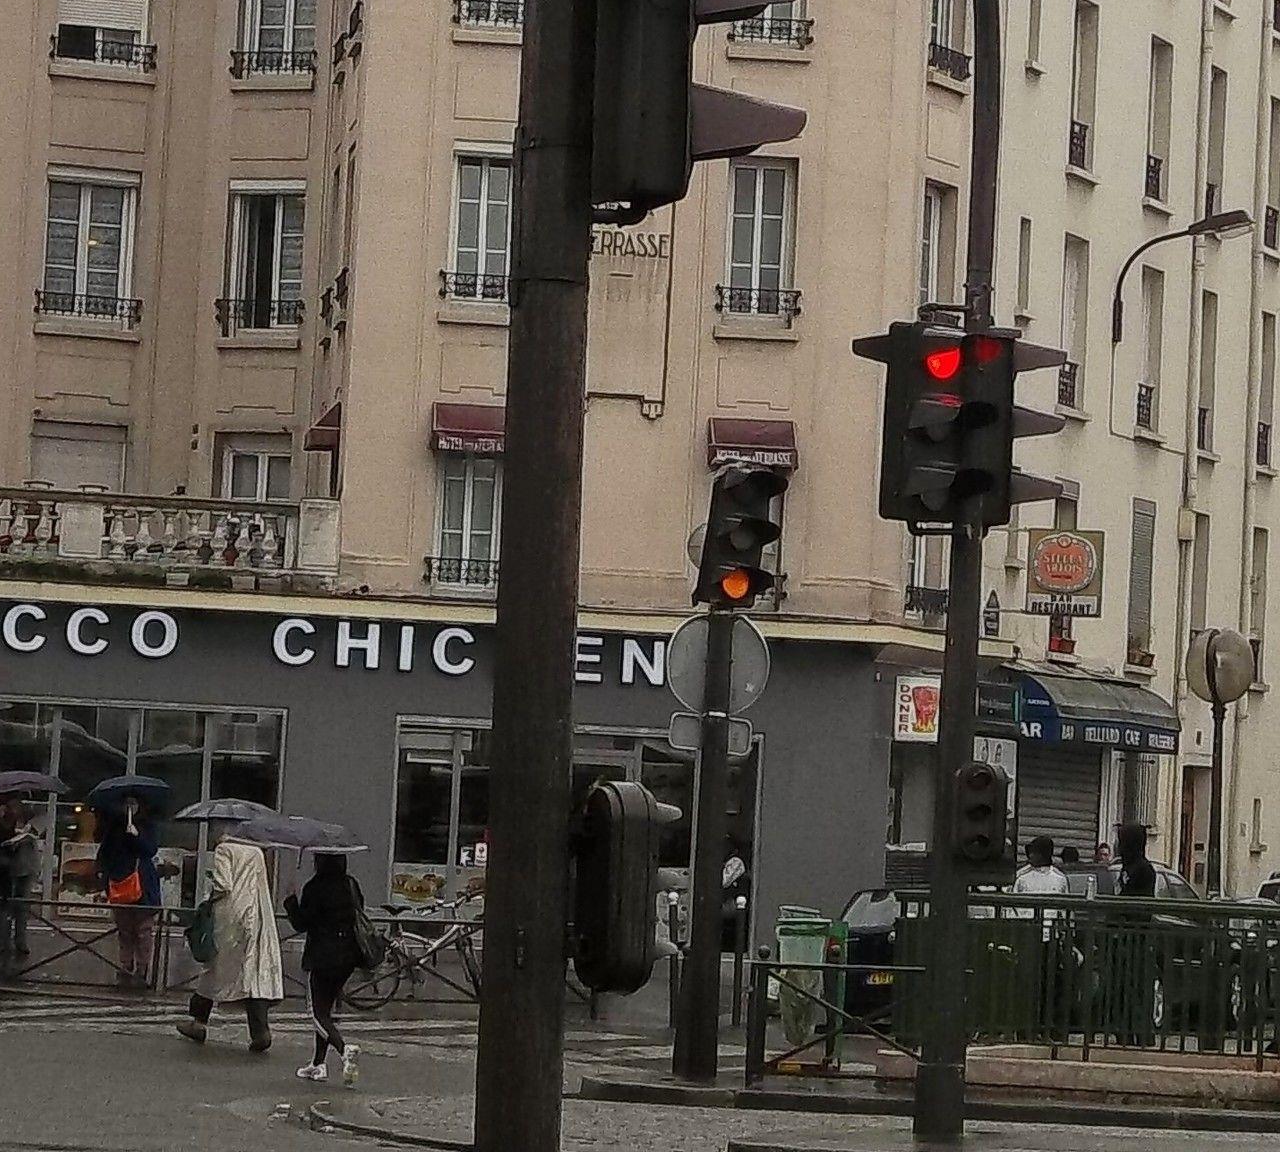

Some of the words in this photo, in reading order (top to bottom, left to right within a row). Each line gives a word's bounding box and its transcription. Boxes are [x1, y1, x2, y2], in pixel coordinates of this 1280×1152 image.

[591, 230, 670, 259] ERRASSE
[1031, 602, 1092, 615] RESTAURANT
[272, 618, 666, 686] CHICEN
[1019, 722, 1043, 738] AR
